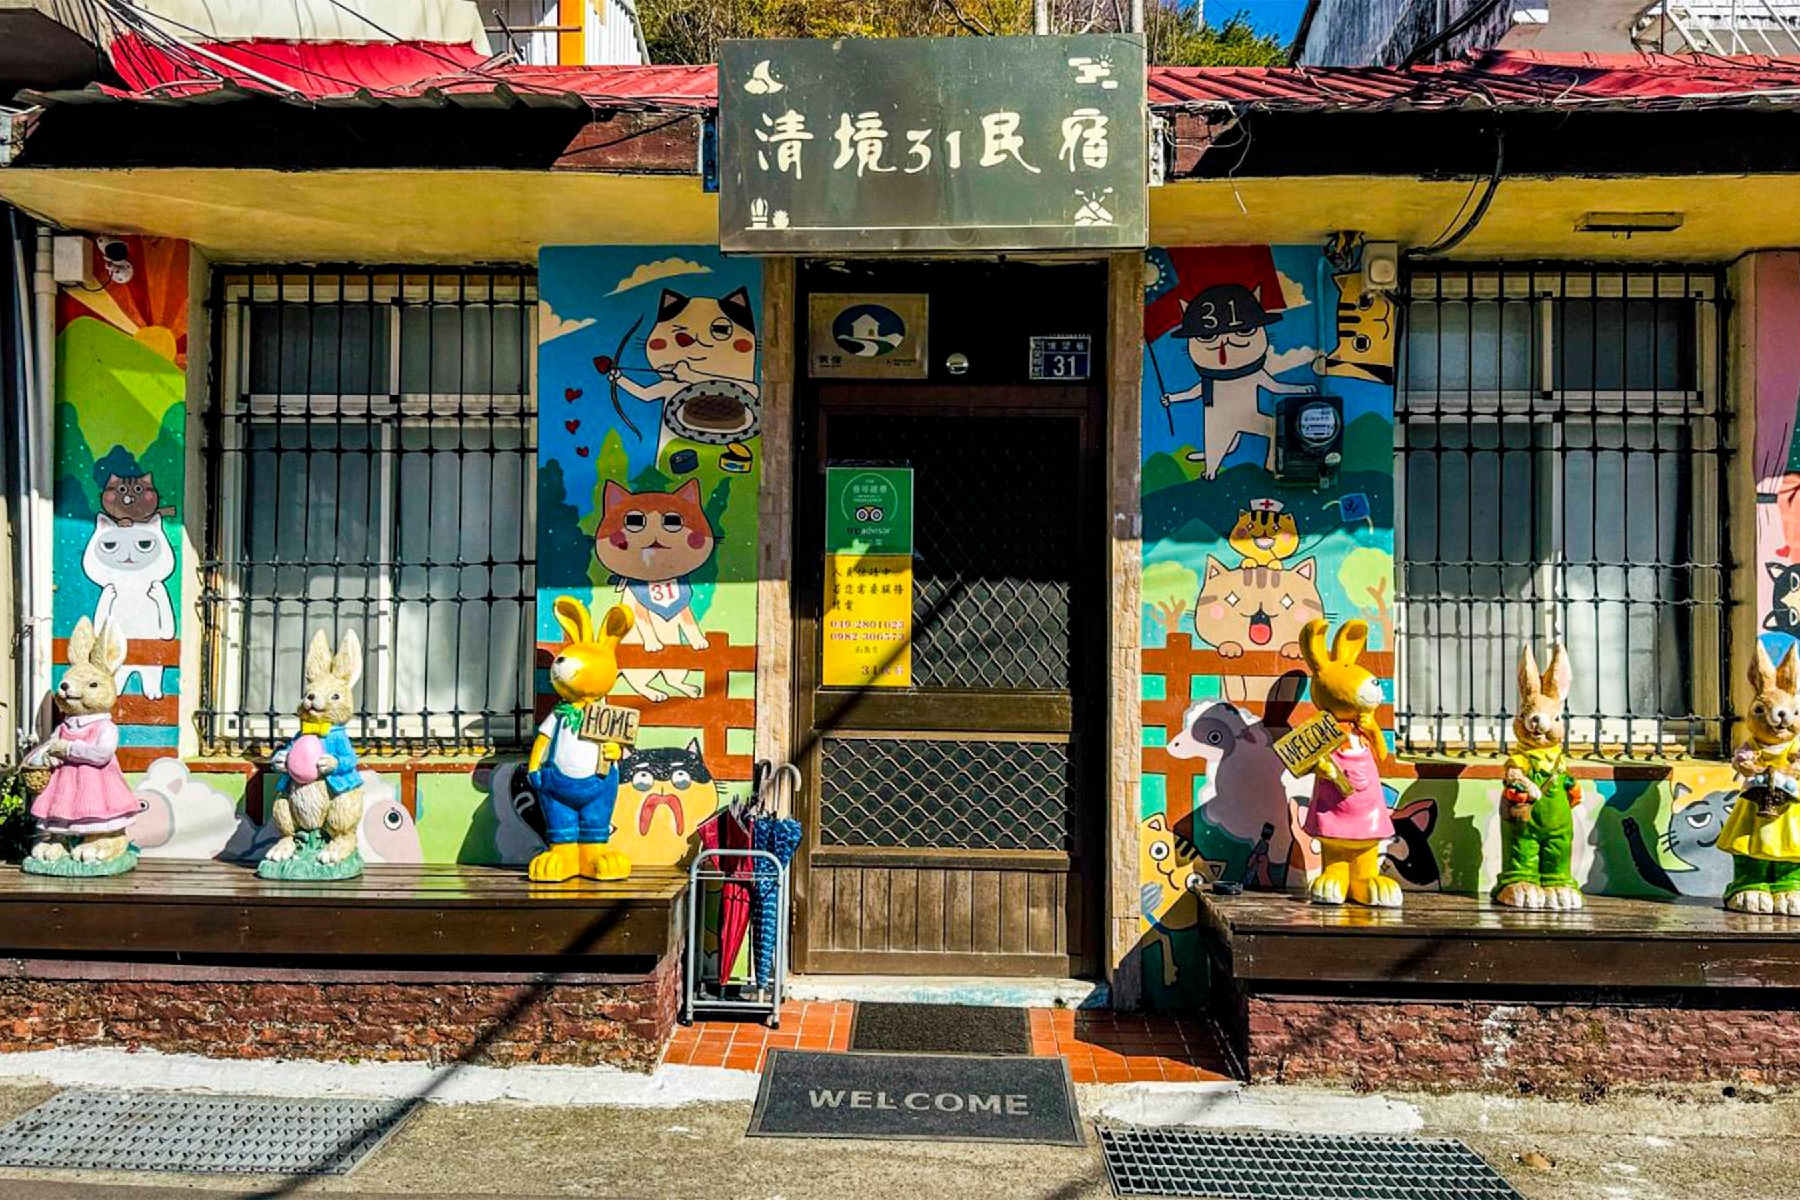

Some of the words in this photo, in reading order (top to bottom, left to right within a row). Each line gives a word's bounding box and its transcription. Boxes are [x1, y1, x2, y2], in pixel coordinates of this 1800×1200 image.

[1200, 300, 1243, 328] 31
[1053, 355, 1076, 376] 31
[651, 582, 675, 601] 31
[586, 707, 635, 740] HOME
[1279, 713, 1343, 765] WELCOME
[808, 1089, 1030, 1115] WELCOME
